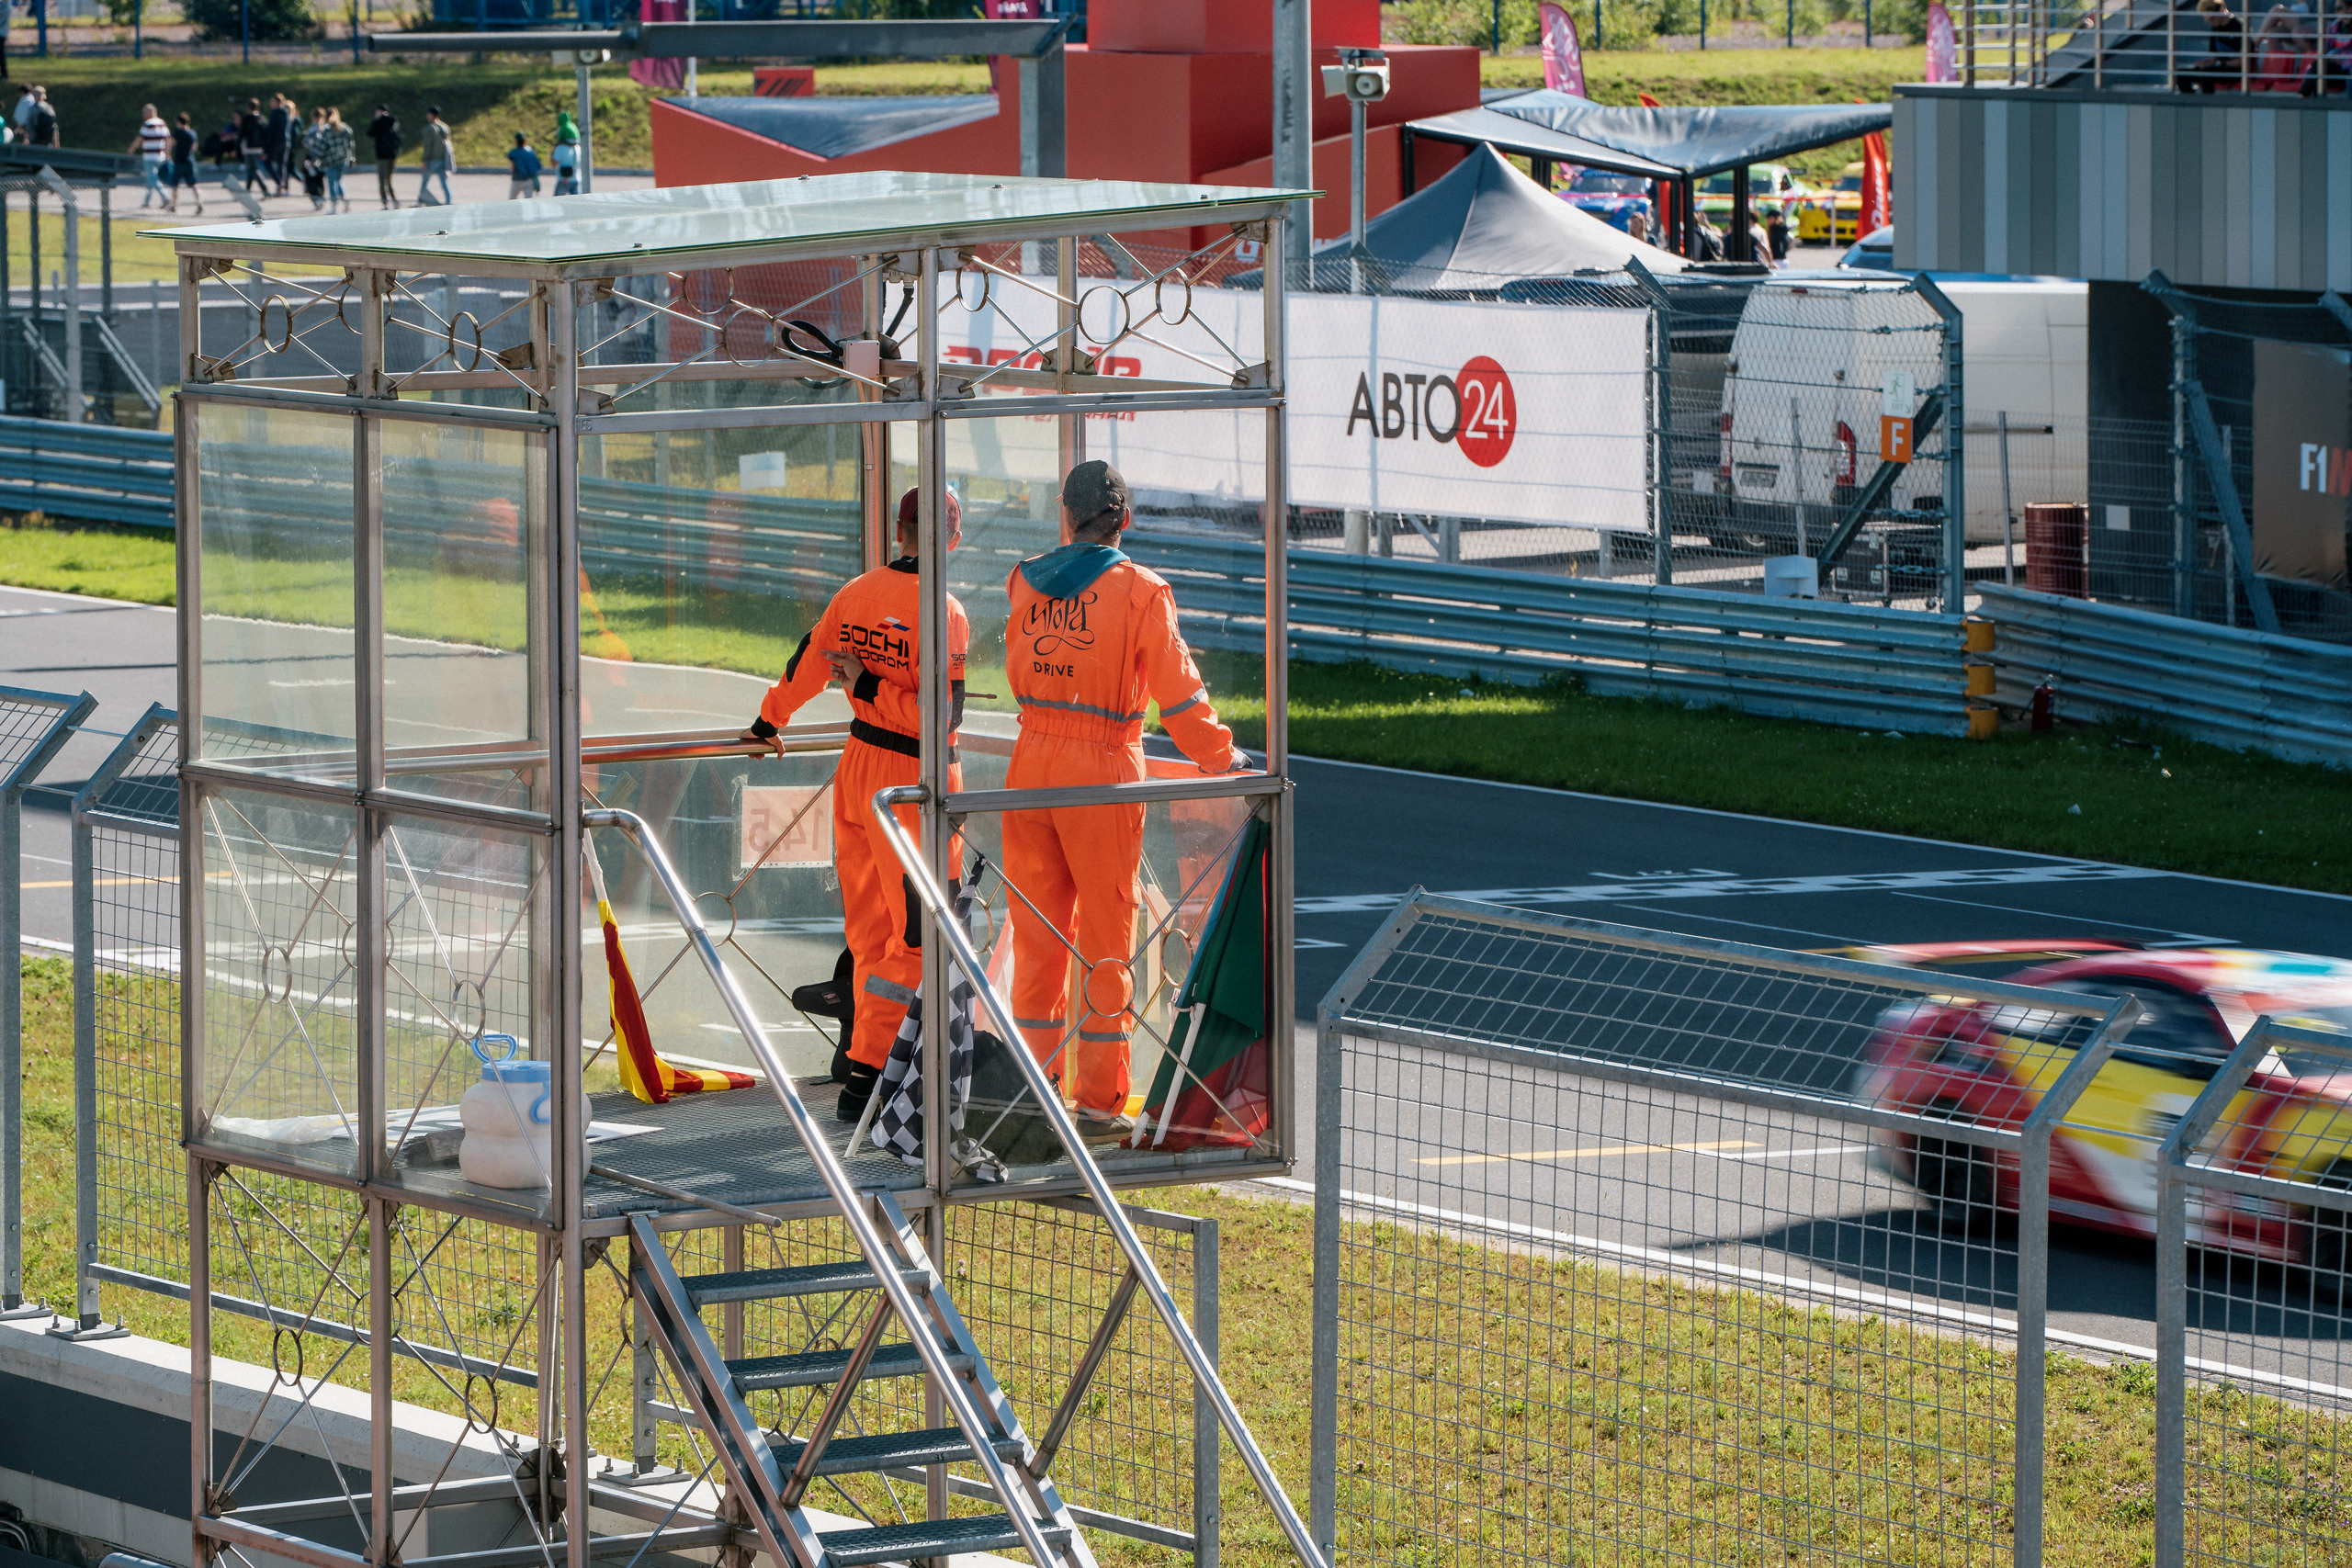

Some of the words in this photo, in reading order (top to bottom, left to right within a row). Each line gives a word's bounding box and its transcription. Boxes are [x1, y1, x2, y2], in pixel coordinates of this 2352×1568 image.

[1891, 422, 1905, 456] F
[839, 624, 910, 658] SOCHI
[1034, 661, 1074, 678] DRIVE
